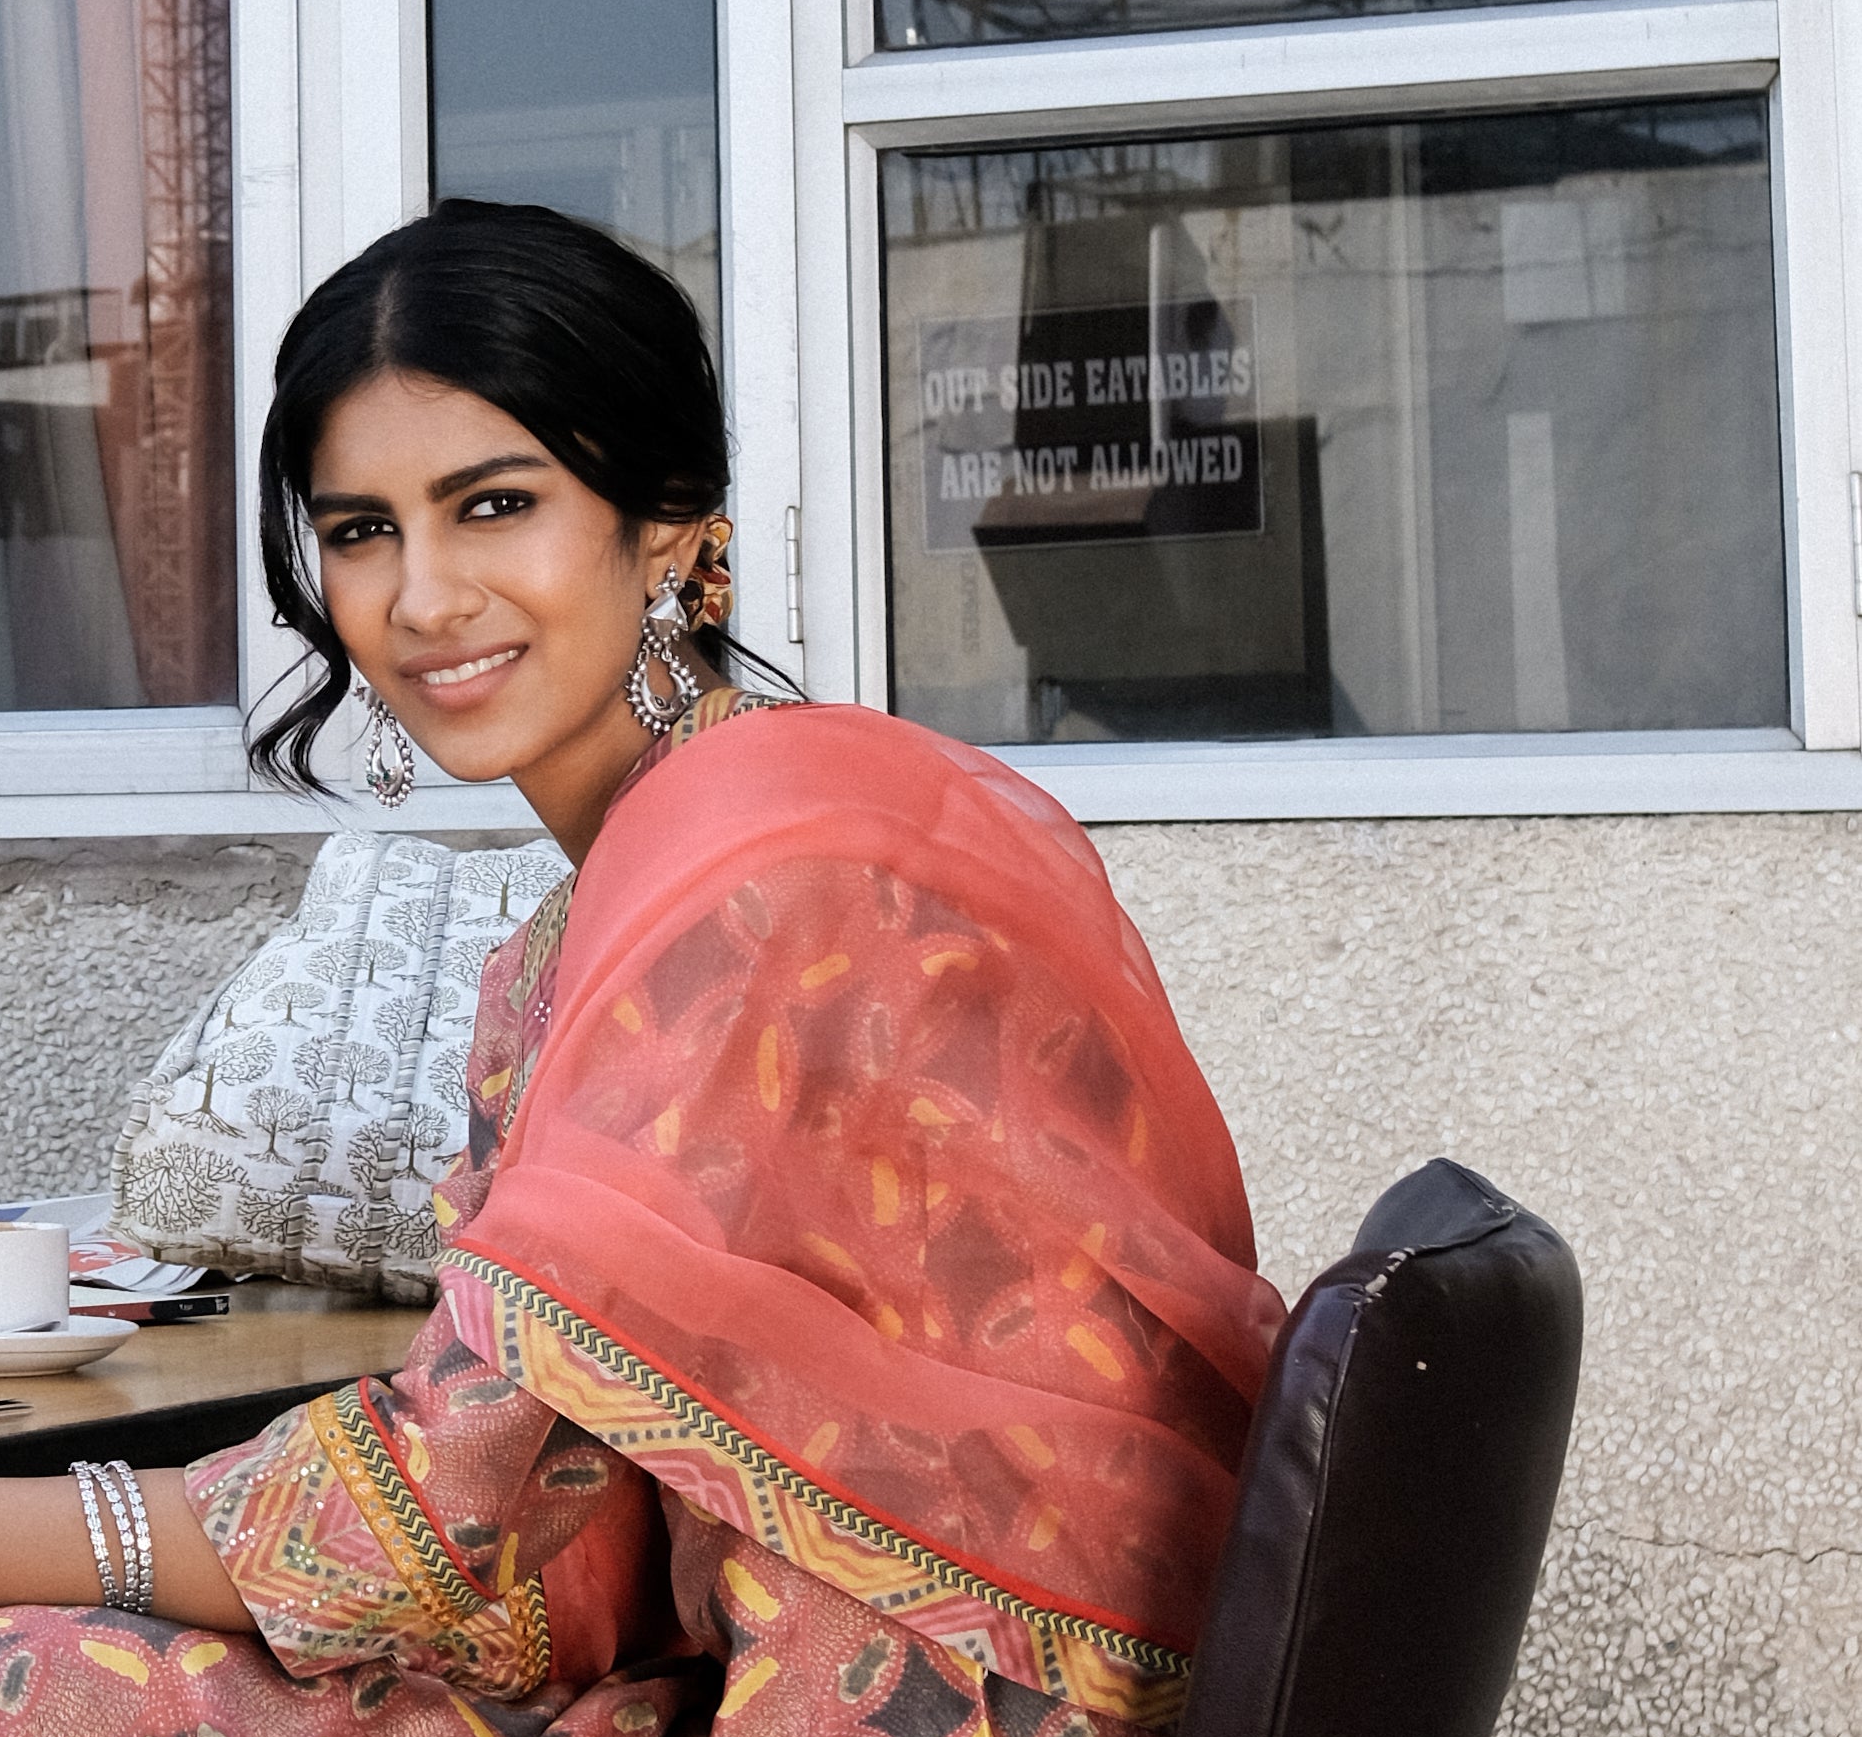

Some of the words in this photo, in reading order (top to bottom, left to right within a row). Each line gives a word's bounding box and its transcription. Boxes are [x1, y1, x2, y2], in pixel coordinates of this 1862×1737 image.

[925, 367, 988, 416] OUT
[1000, 362, 1075, 413] SIDE
[1086, 346, 1251, 405] EATABLES
[940, 451, 1002, 500] ARE
[1012, 446, 1078, 496] NOT
[1089, 435, 1243, 491] ALLOWED
